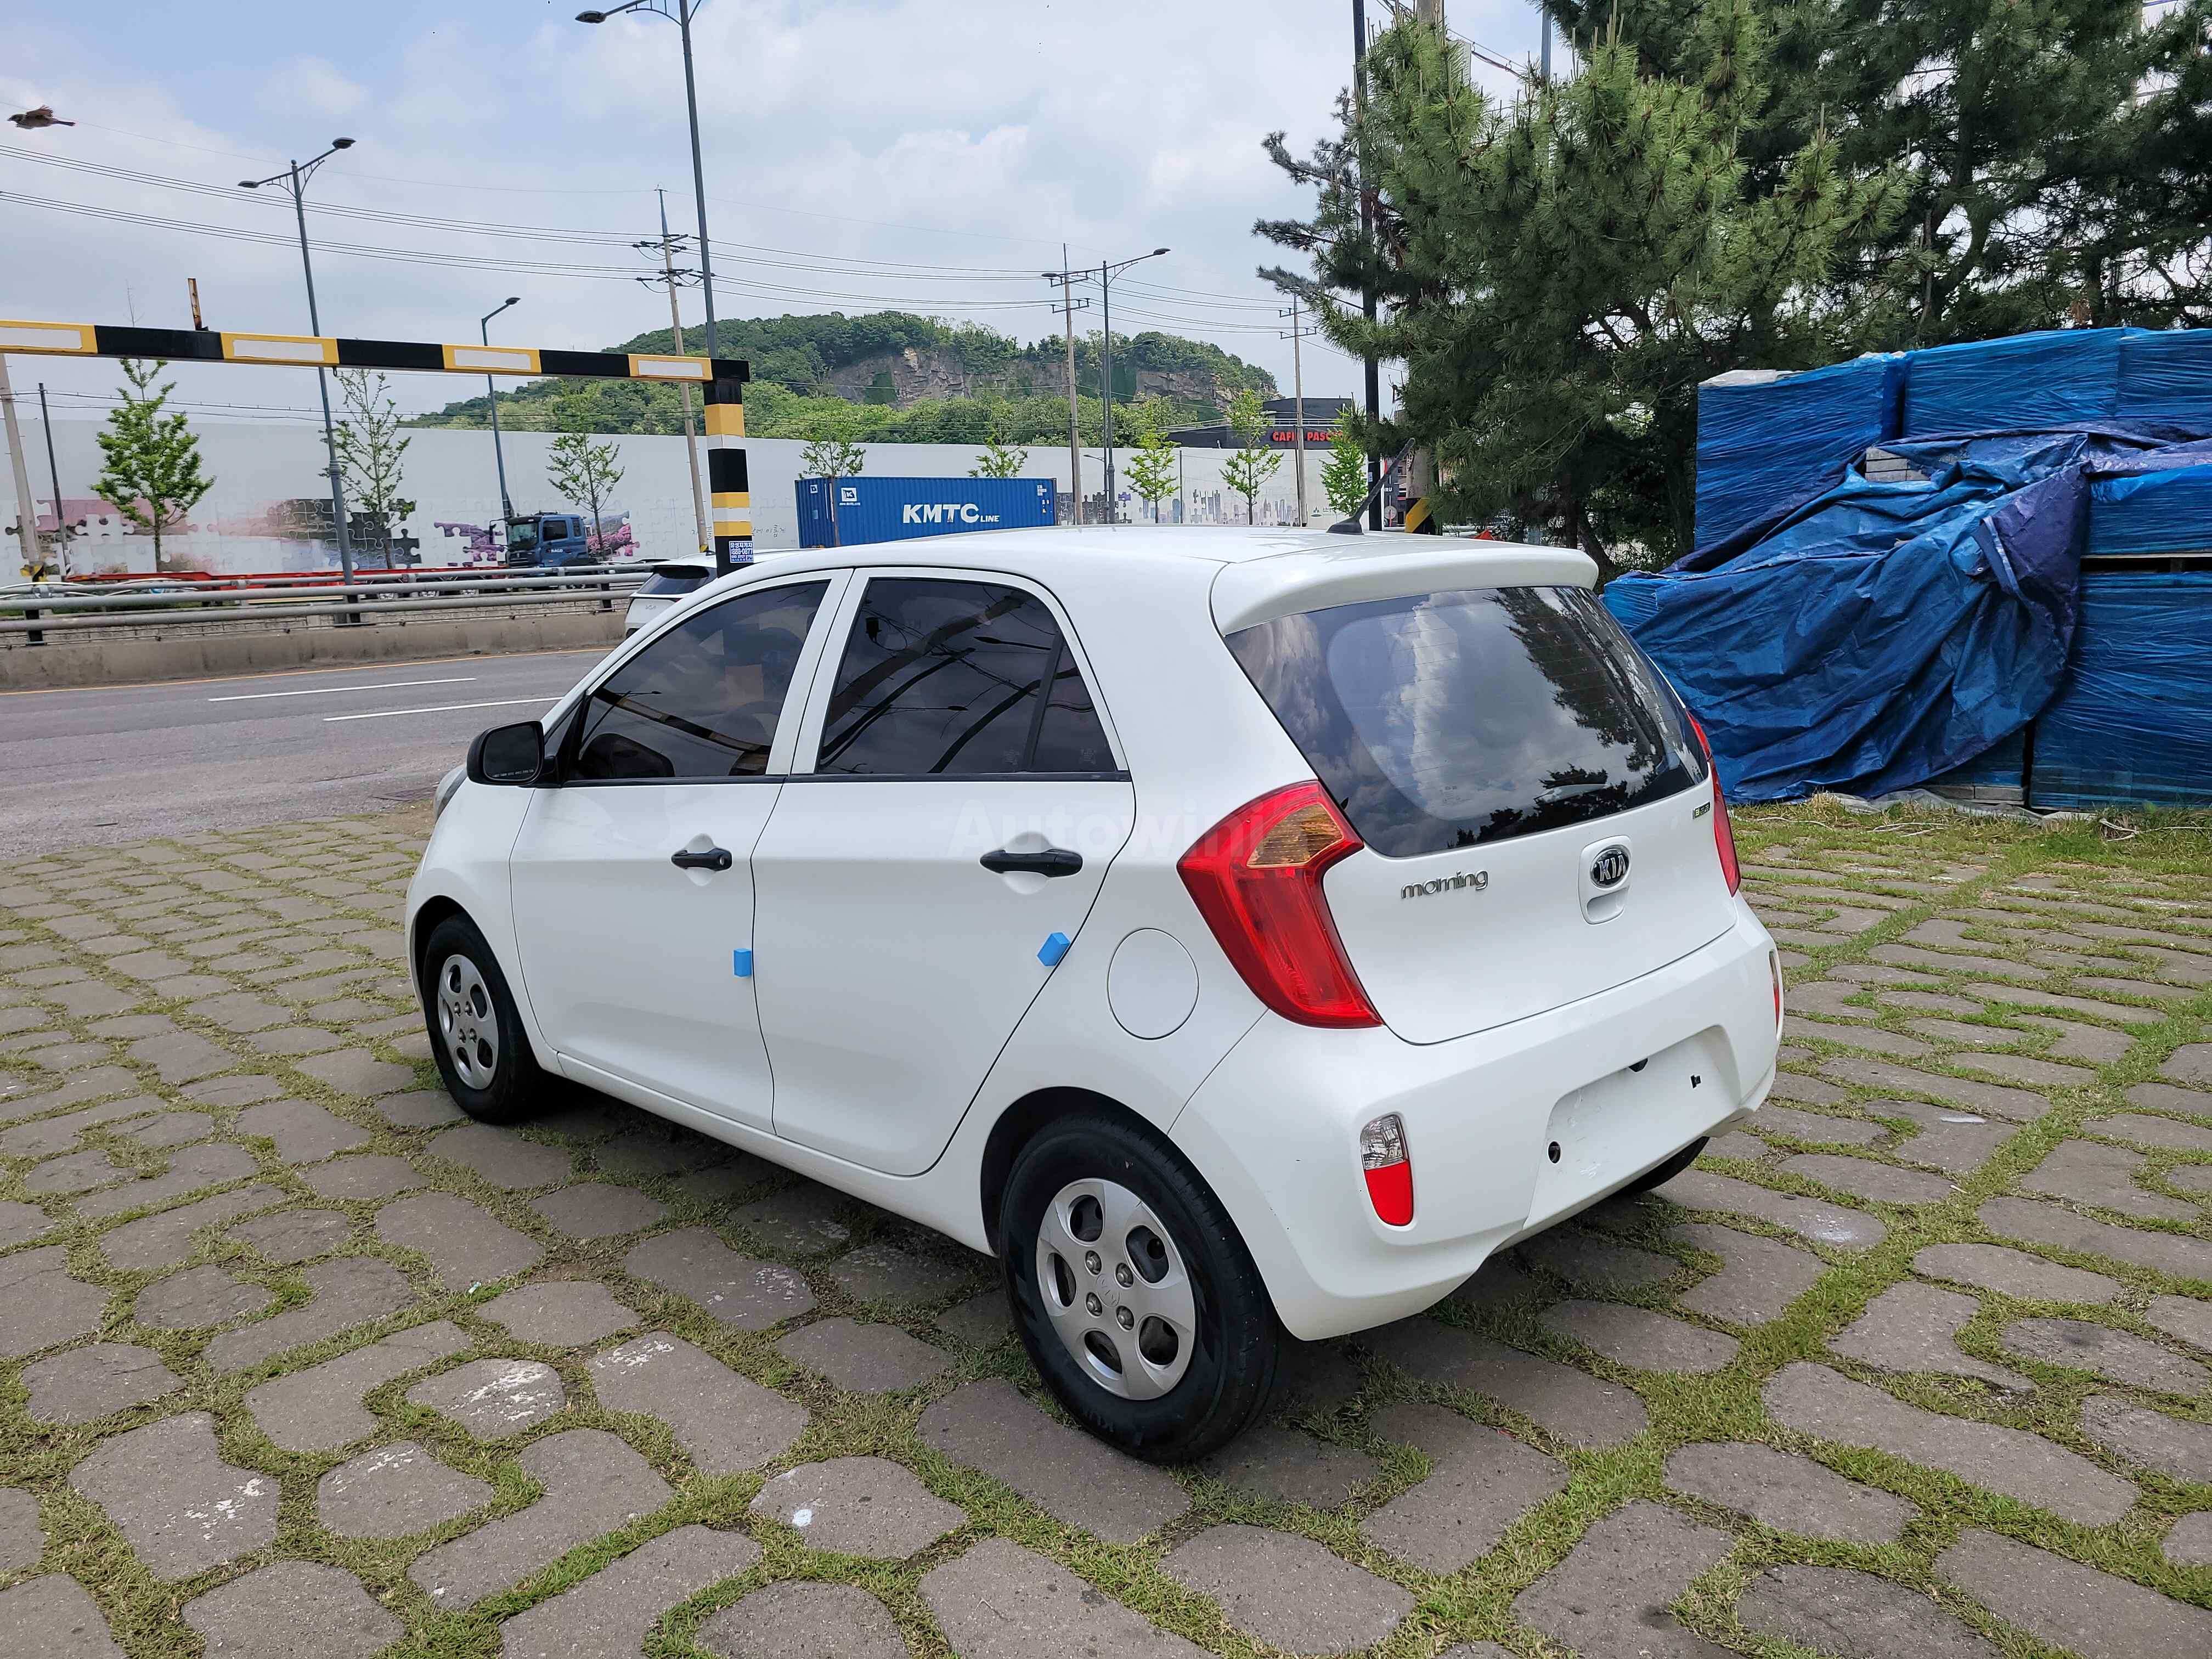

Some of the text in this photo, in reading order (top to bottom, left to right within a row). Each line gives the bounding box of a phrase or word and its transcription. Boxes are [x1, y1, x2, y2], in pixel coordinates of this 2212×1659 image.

[903, 503, 979, 523] KMTC
[1597, 855, 1626, 882] KIA
[1401, 869, 1488, 899] morning
